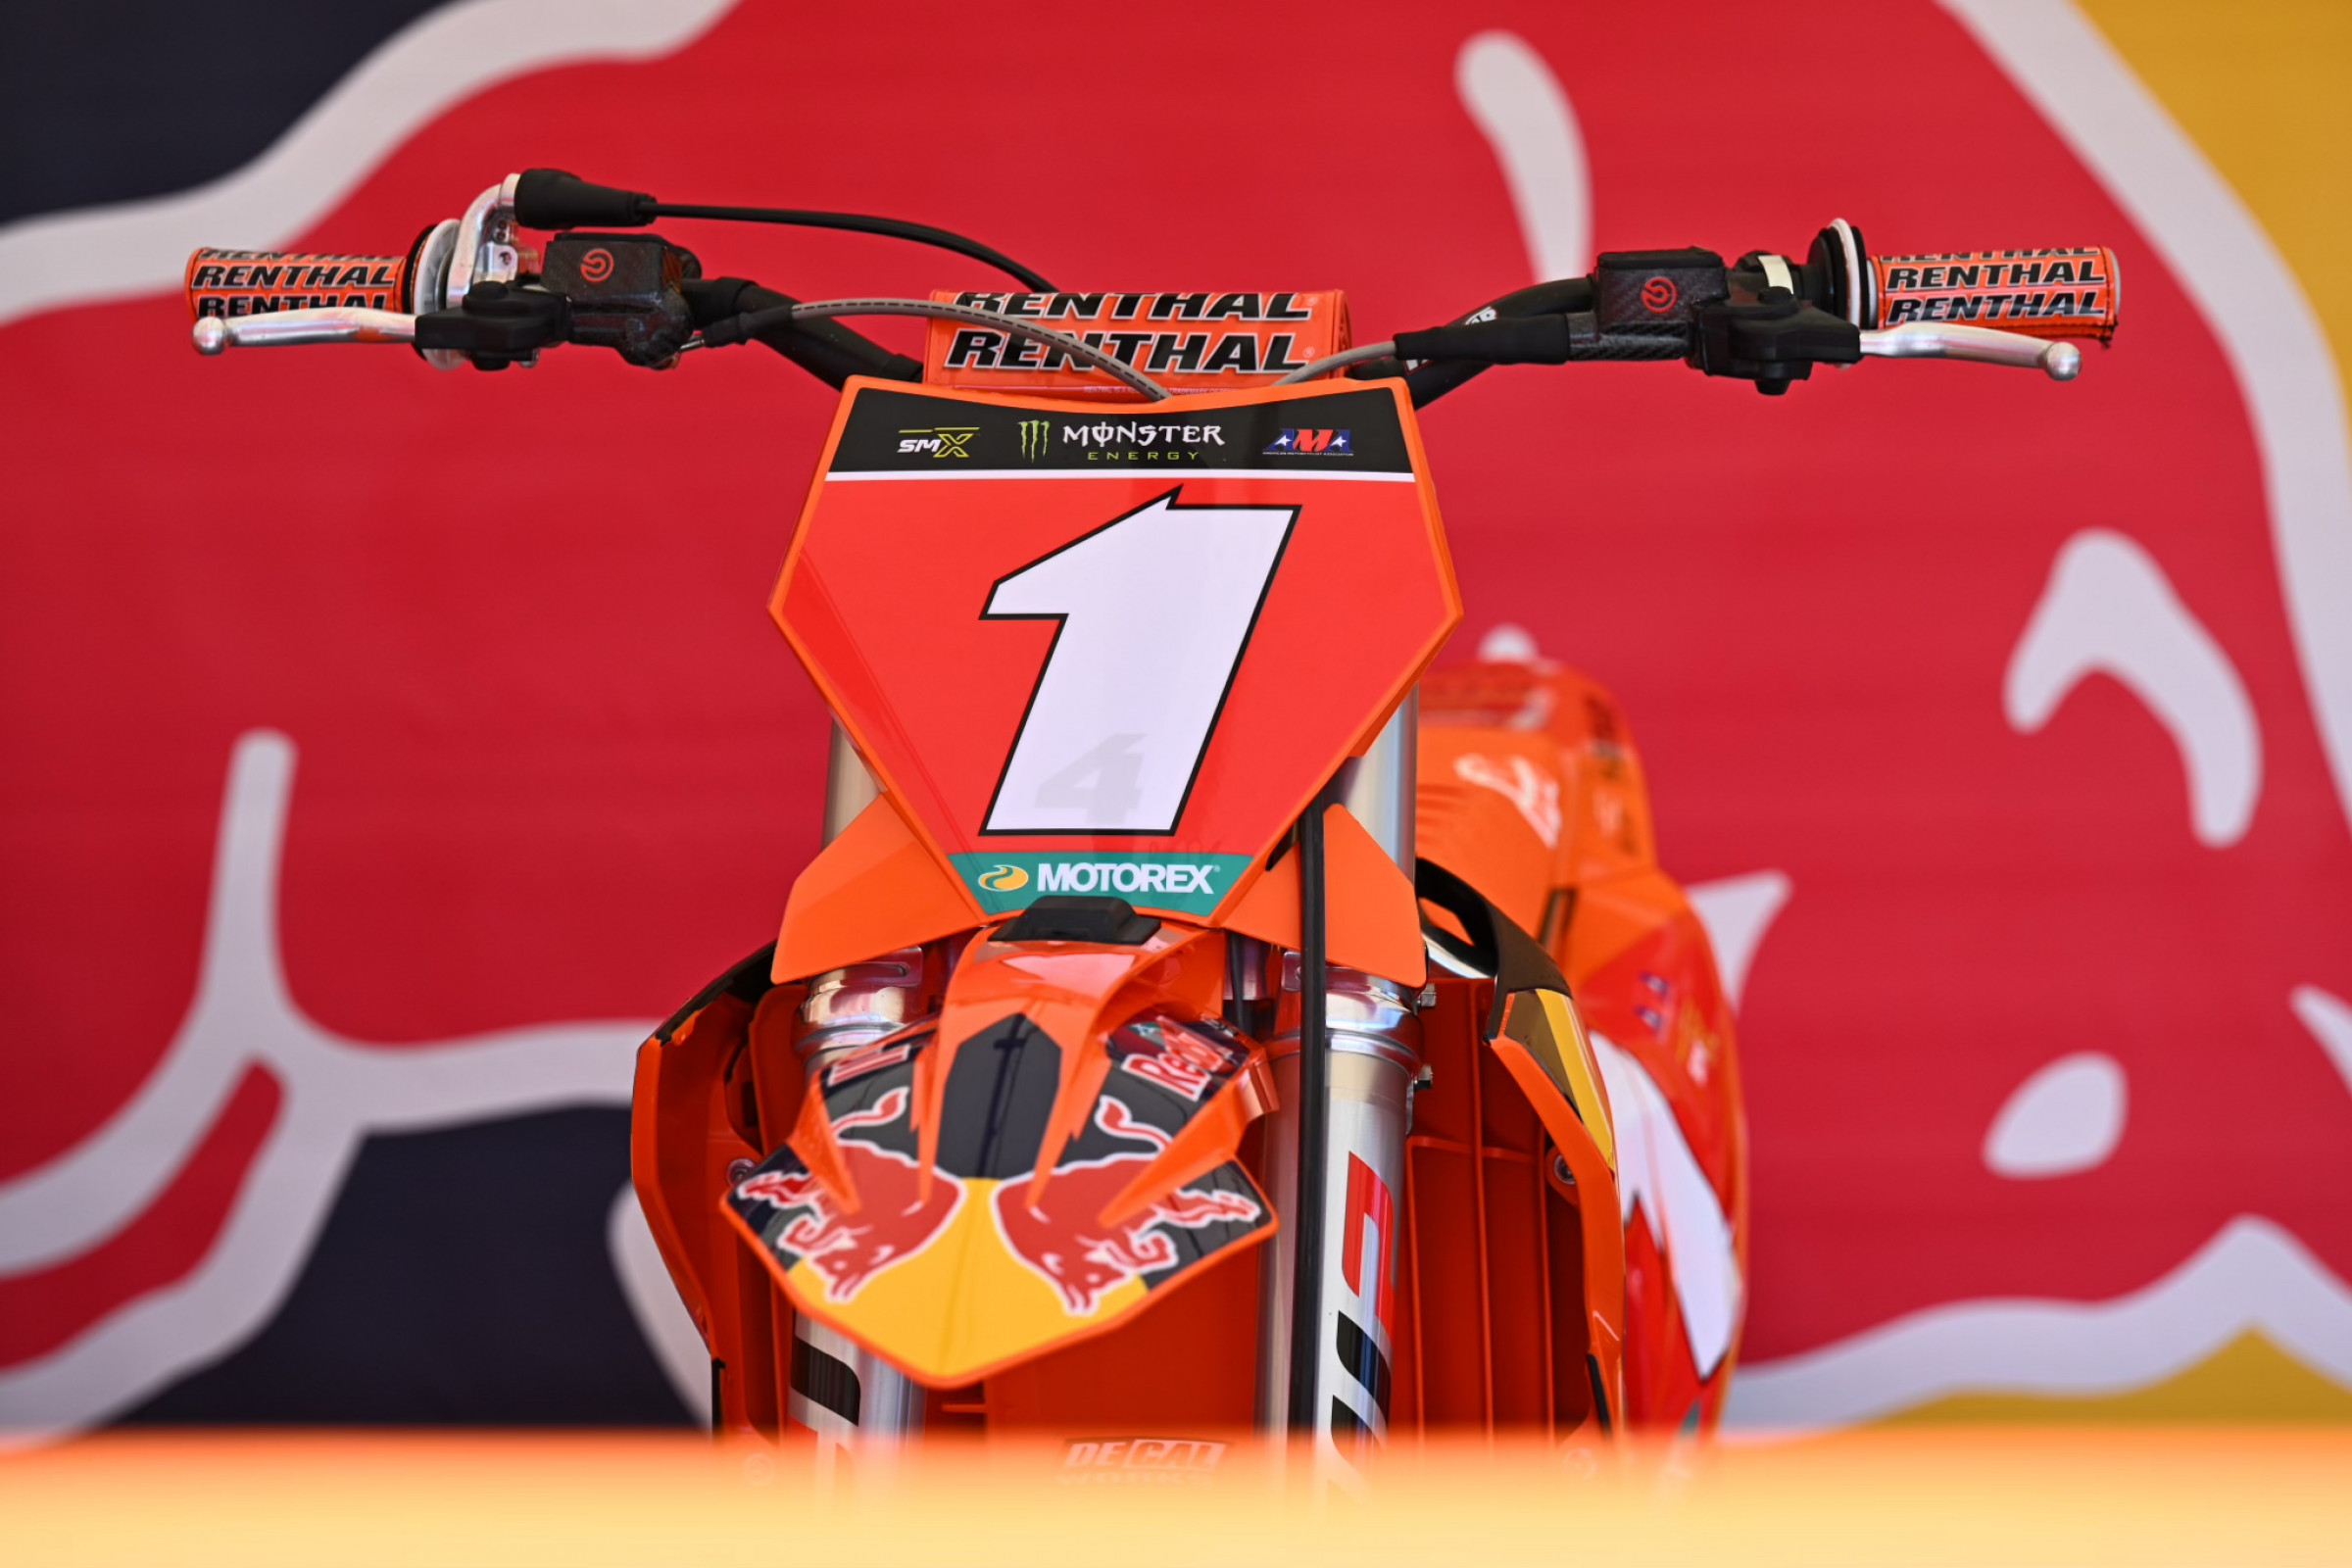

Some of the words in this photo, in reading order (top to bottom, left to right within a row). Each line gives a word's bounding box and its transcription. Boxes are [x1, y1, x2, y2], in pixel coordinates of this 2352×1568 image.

[191, 263, 395, 291] RENTHAL
[1886, 260, 2105, 292] RENTHAL
[1886, 290, 2105, 325] RENTHAL
[944, 328, 1310, 374] RENTHAL
[897, 433, 974, 458] SMX
[1062, 421, 1225, 448] MONSTER
[1262, 428, 1355, 452] AMA
[1087, 451, 1199, 461] ENERGY
[977, 483, 1302, 836] 1
[1033, 733, 1150, 825] 4
[1037, 861, 1215, 894] MOTOREX
